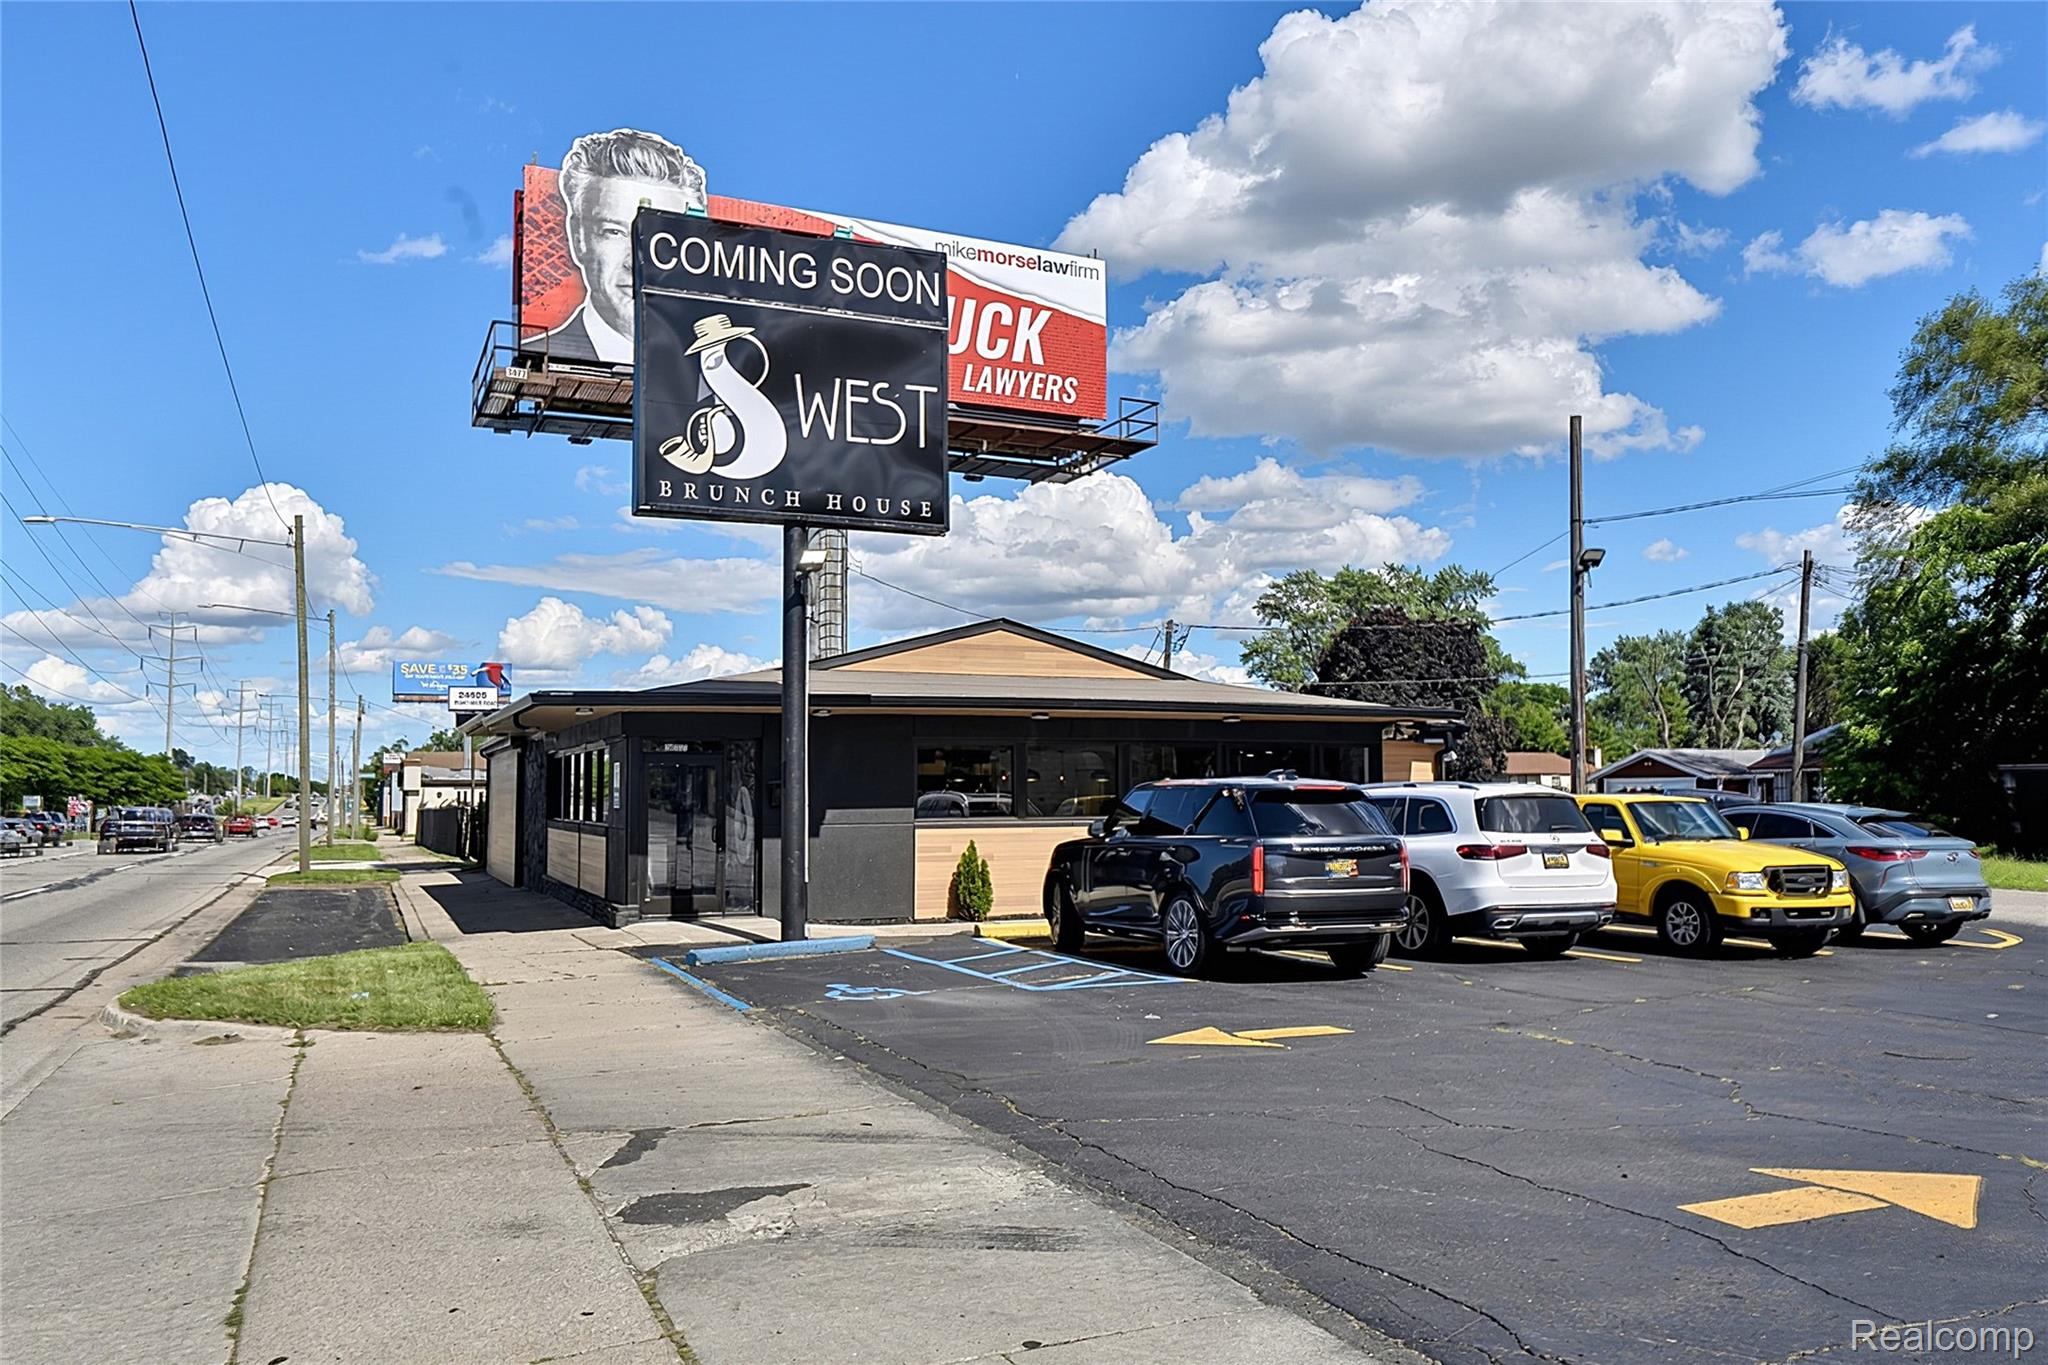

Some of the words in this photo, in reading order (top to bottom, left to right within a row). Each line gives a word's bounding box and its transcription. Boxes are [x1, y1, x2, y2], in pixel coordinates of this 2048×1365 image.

[650, 232, 818, 289] COMING
[830, 257, 940, 307] SOON
[962, 363, 1079, 405] LAWYERS
[794, 373, 939, 449] WEST
[659, 480, 801, 508] BRUNCH
[826, 493, 933, 518] HOUSE
[401, 663, 436, 674] SAVE
